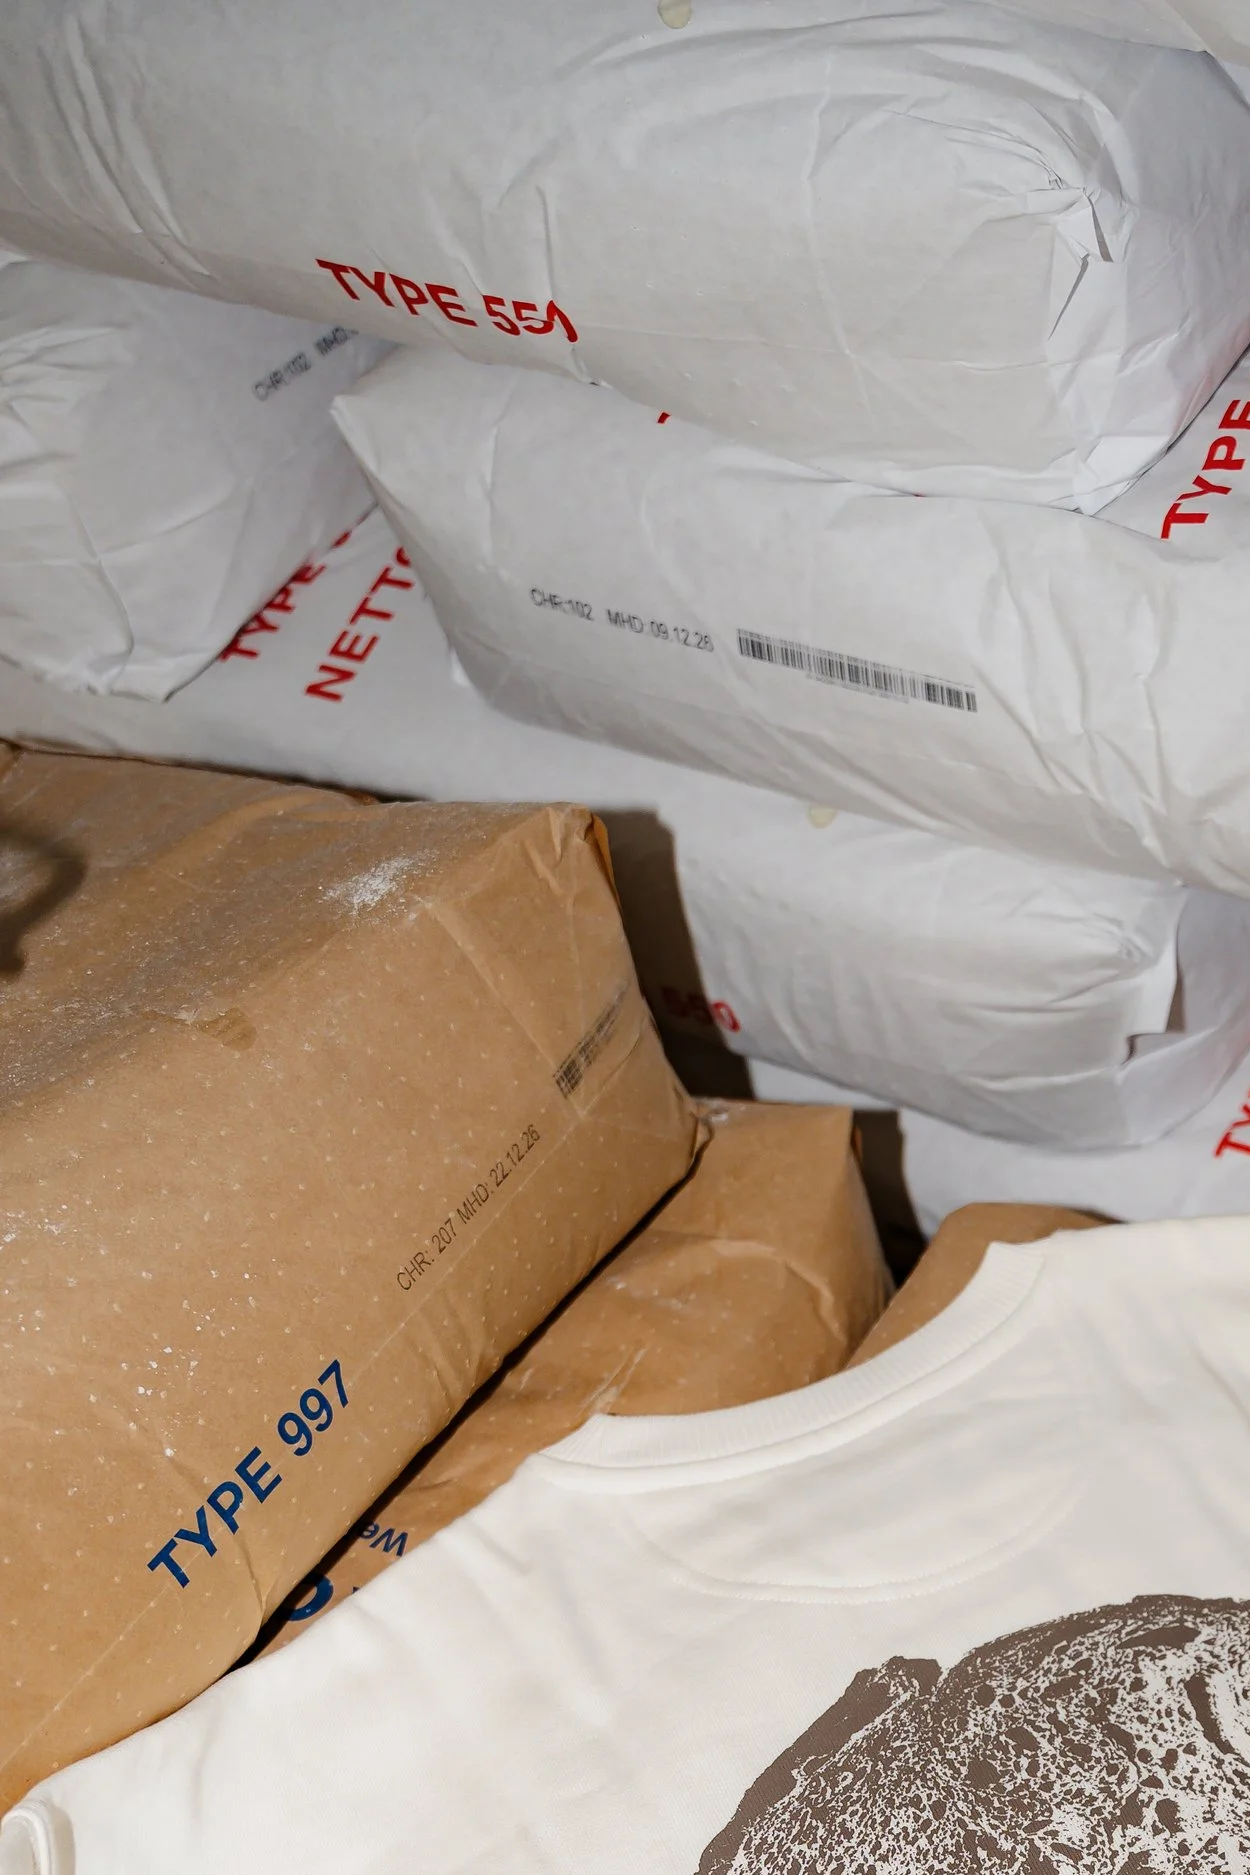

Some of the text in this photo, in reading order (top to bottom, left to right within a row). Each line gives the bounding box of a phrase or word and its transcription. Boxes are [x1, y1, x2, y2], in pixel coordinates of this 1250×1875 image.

[316, 259, 477, 327] TYPE
[305, 548, 413, 702] NETT
[397, 1124, 542, 1292] CHR: 207 MHD: 22.12.26
[147, 1447, 282, 1588] TYPE
[277, 1359, 350, 1457] 997
